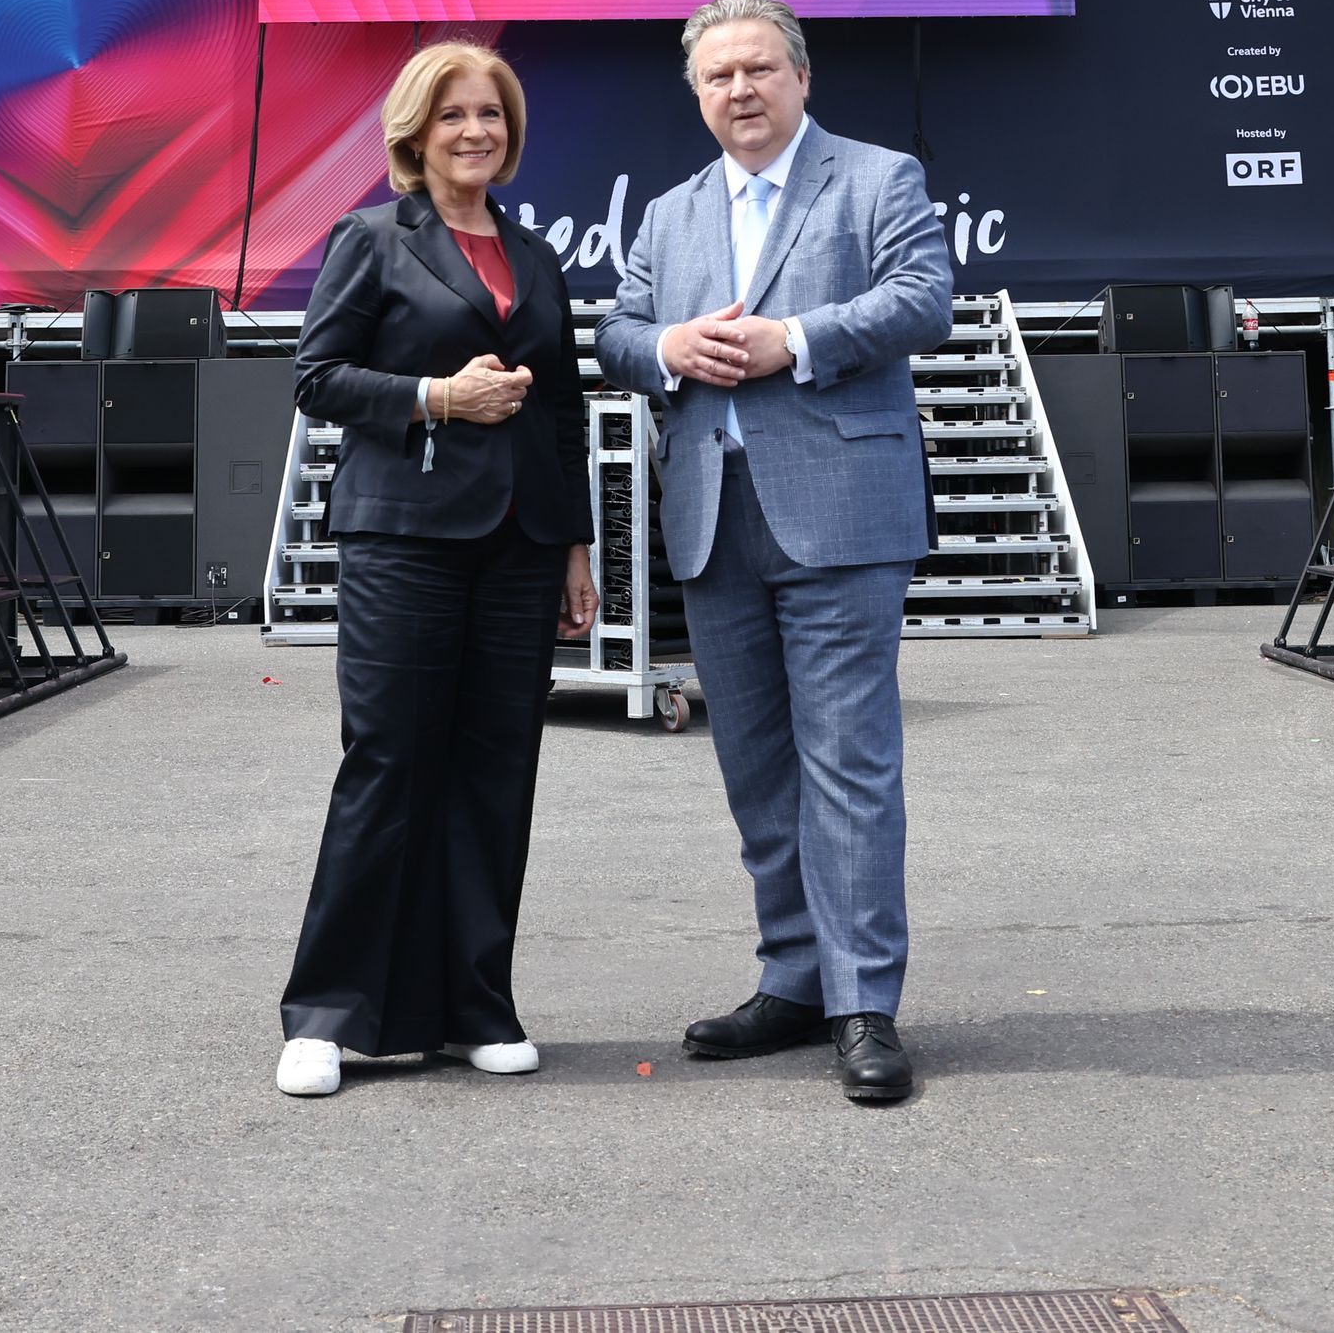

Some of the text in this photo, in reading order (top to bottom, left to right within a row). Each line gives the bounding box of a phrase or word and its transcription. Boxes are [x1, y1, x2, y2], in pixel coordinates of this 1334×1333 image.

[1239, 4, 1295, 19] Vienna
[1227, 46, 1282, 57] Created by
[1255, 74, 1305, 96] EBU
[1236, 128, 1287, 140] Hosted by
[1232, 158, 1296, 180] ORF
